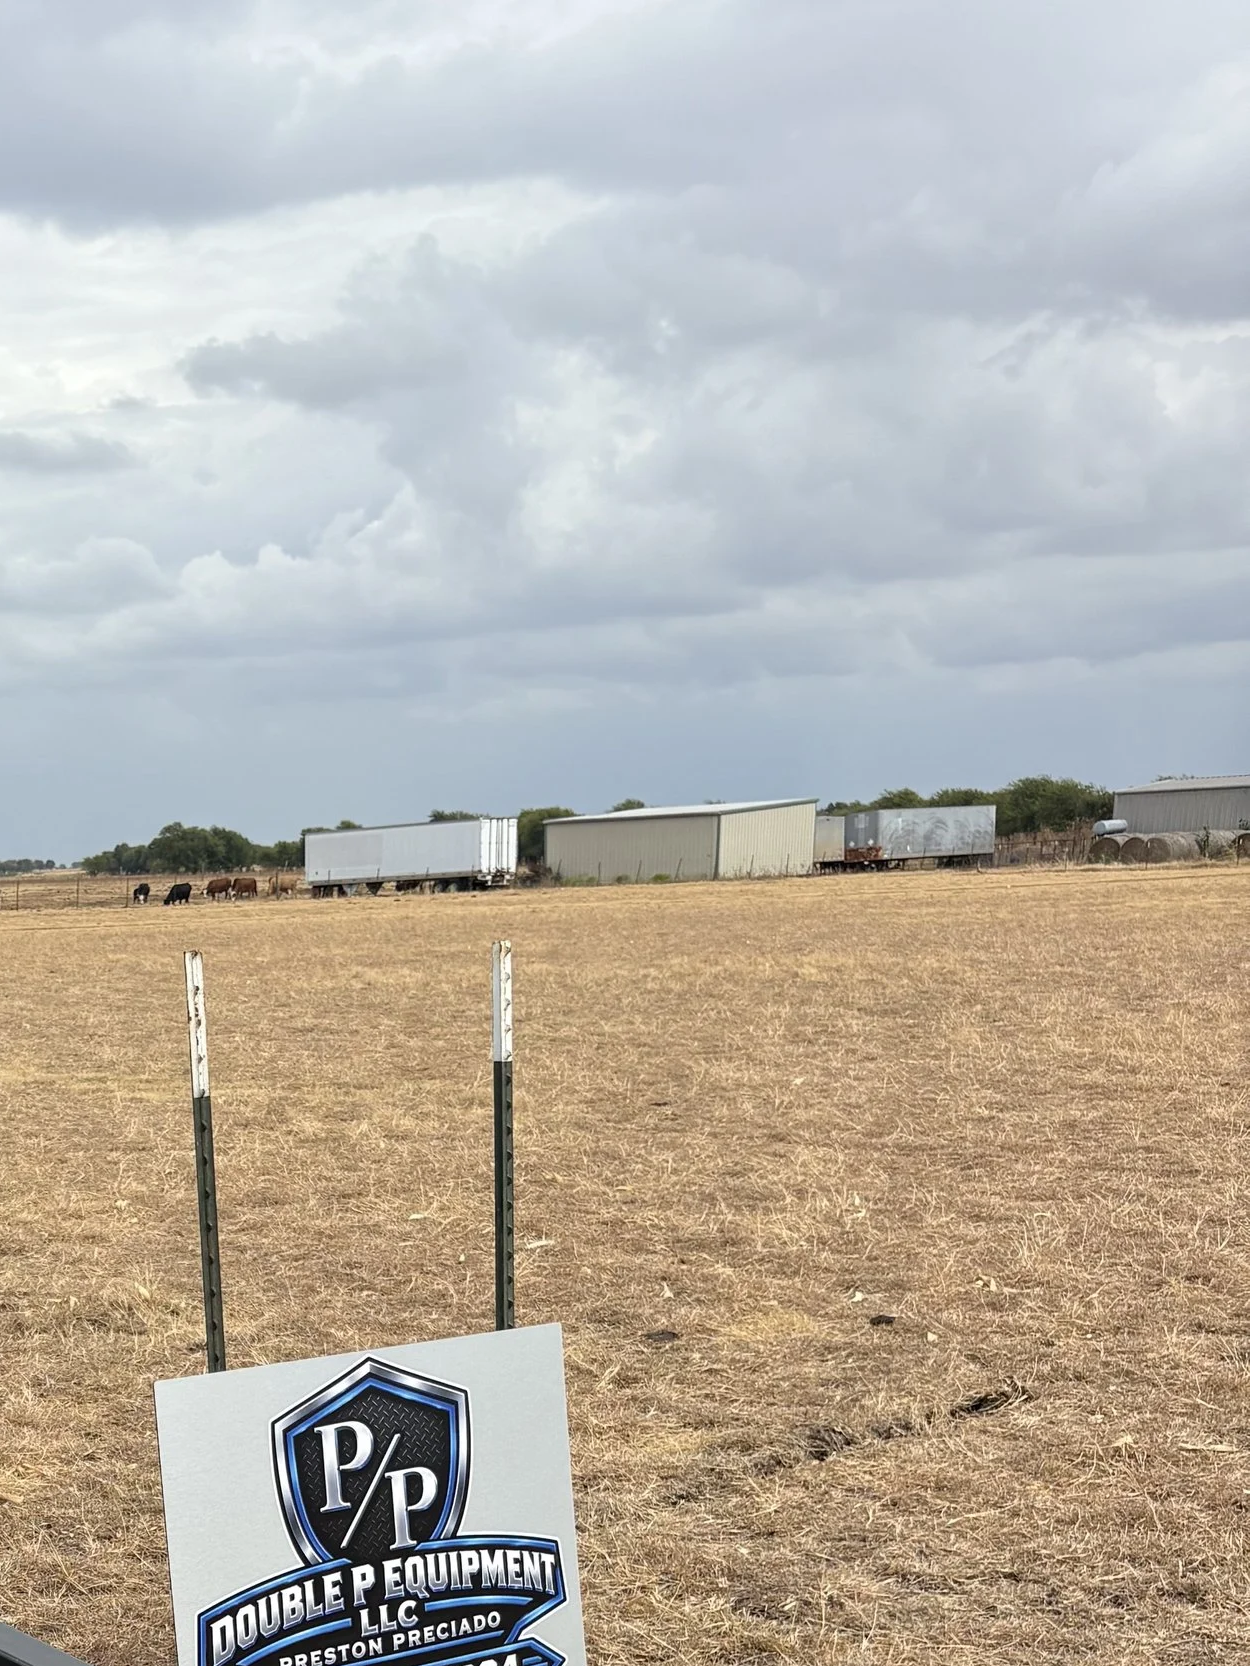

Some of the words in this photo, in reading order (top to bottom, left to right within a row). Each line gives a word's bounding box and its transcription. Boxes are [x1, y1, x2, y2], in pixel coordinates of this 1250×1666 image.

[350, 1562, 377, 1606] P
[382, 1549, 558, 1600] EQUIPMENT
[360, 1601, 420, 1637] LLC
[392, 1610, 502, 1653] PRECIADO
